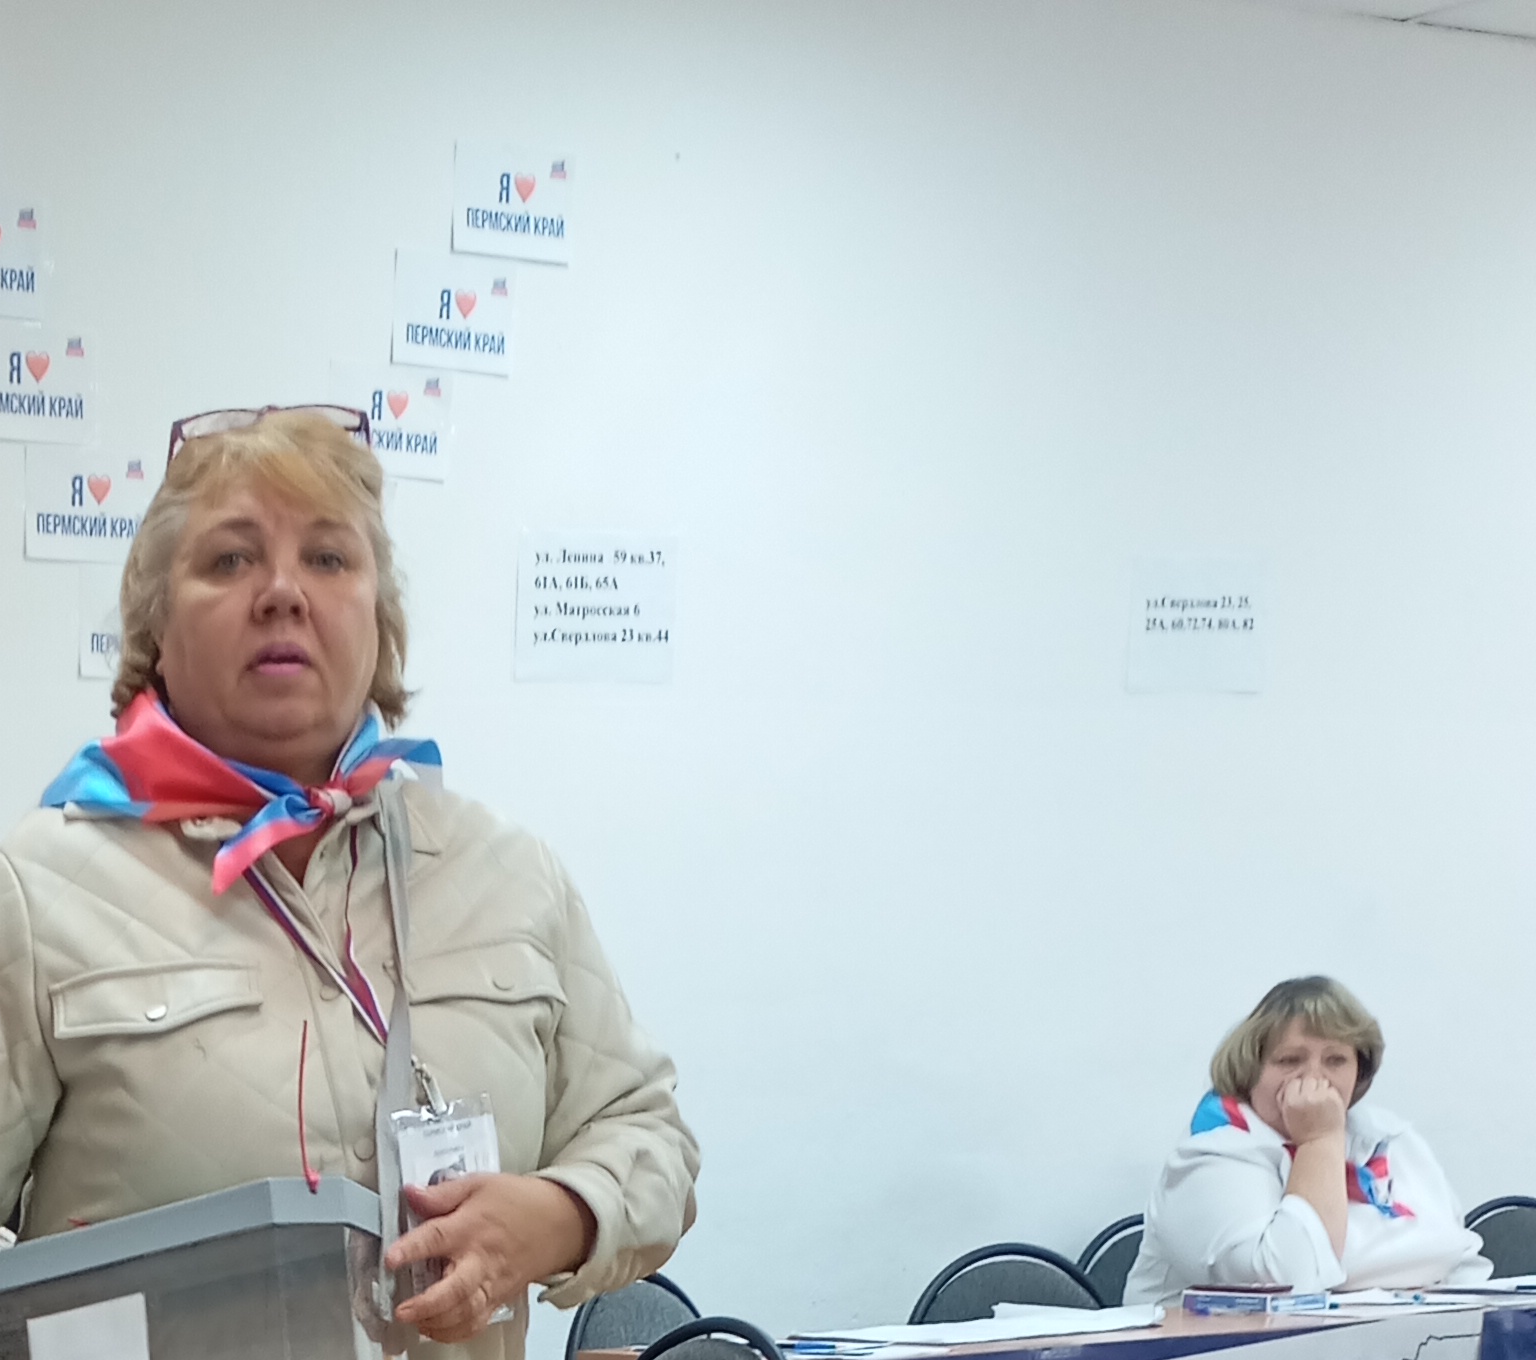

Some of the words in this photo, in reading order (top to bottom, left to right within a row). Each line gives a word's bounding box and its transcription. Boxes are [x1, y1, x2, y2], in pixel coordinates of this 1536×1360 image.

[498, 173, 510, 203] Я
[466, 207, 530, 234] ПЕРМСКИЙ
[533, 214, 565, 239] КРАЙ
[0, 266, 35, 293] КРАЙ
[440, 289, 451, 320] Я
[406, 323, 471, 351] ПЕРМСКИЙ
[474, 332, 505, 356] КРАЙ
[9, 352, 22, 384] Я
[49, 395, 84, 420] КРАЙ
[371, 390, 383, 421] Я
[405, 431, 438, 455] КРАЙ
[71, 475, 84, 506] Я
[36, 512, 107, 538] ПЕРМСКИЙ
[110, 516, 138, 539] КРА
[535, 552, 553, 566] ул.
[556, 549, 604, 564] Ленина
[614, 550, 627, 563] 59
[534, 576, 562, 591] 61А,
[595, 576, 618, 590] 65А
[533, 605, 551, 619] ул.
[556, 602, 630, 620] Матросская
[634, 604, 640, 616] 6
[533, 628, 617, 646] ул.Свердлова
[621, 629, 634, 642] 23
[637, 629, 669, 643] кв.44
